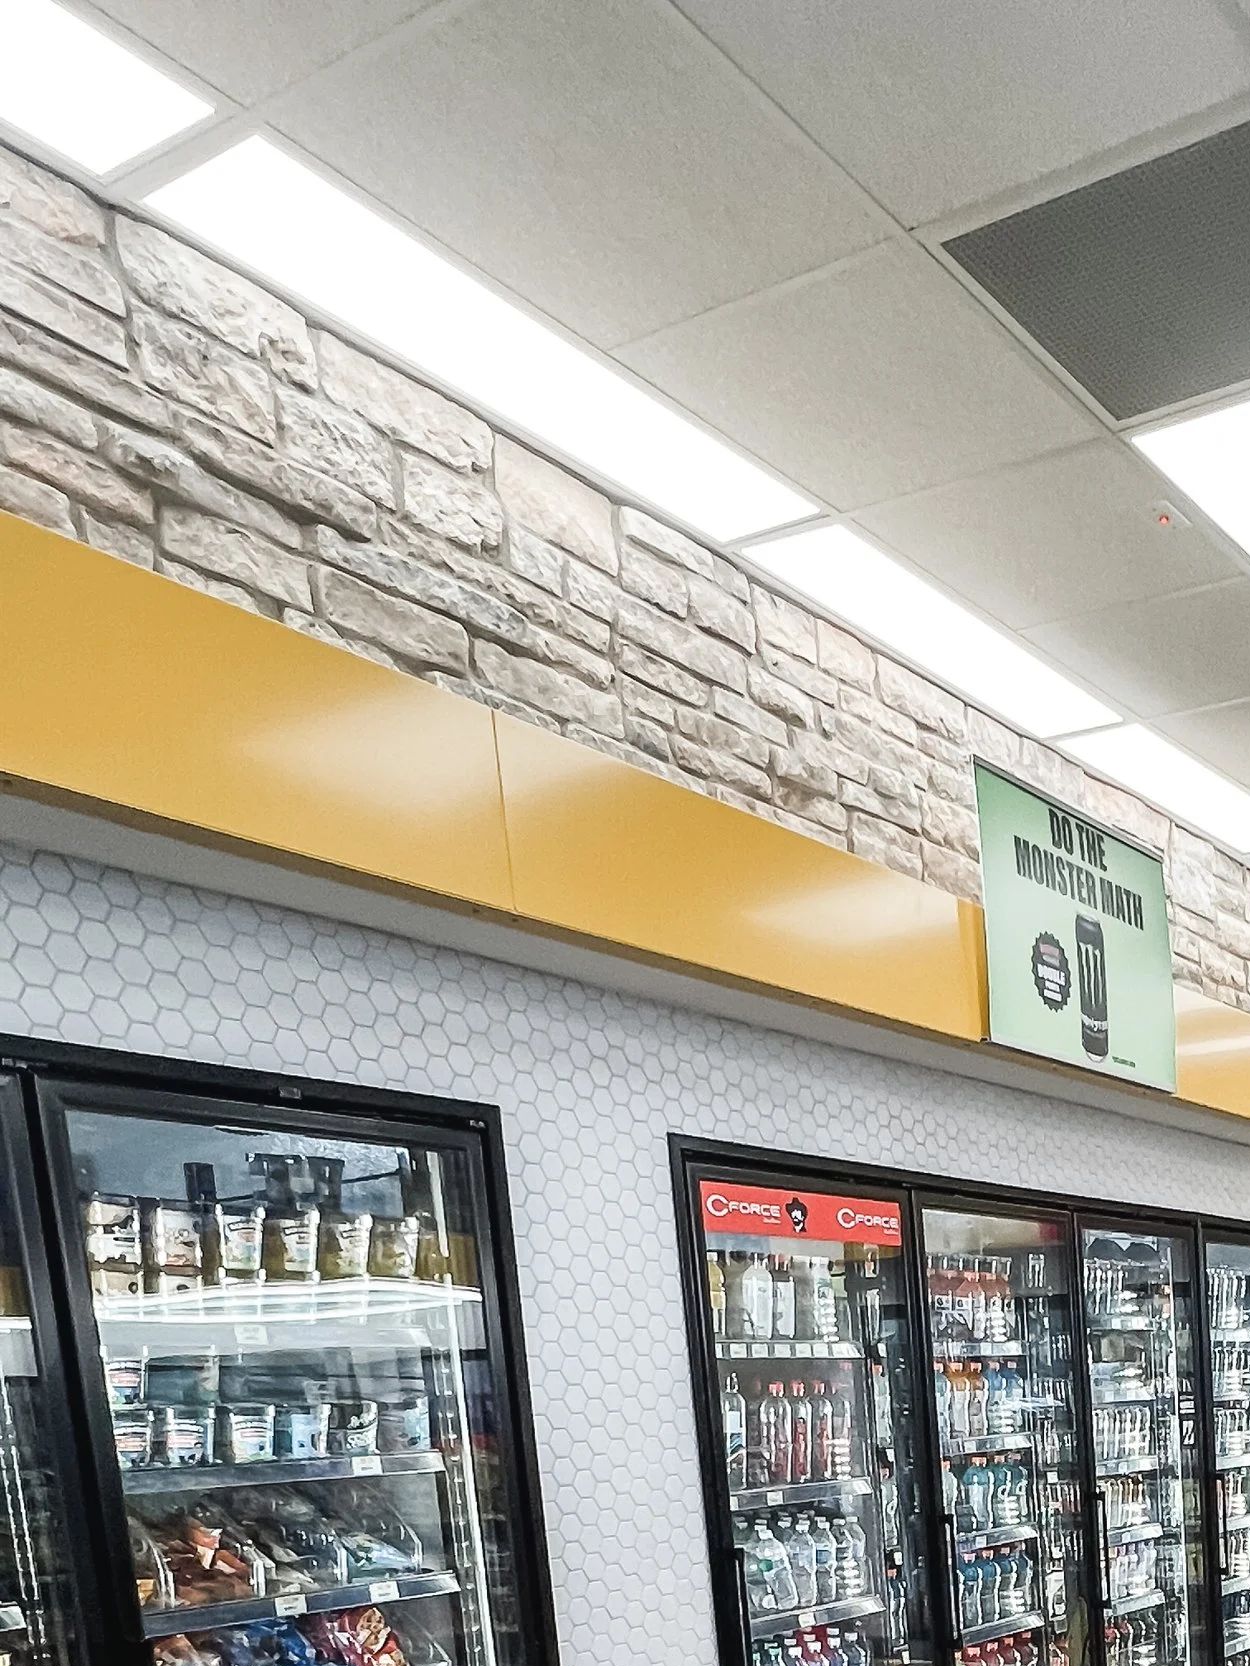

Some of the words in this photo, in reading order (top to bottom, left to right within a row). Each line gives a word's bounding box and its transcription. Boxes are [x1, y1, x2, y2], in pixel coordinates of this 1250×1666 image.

[1048, 808, 1073, 856] DO
[1076, 822, 1107, 872] THE
[1014, 835, 1097, 910] MONSTER
[1100, 877, 1144, 930] MATH
